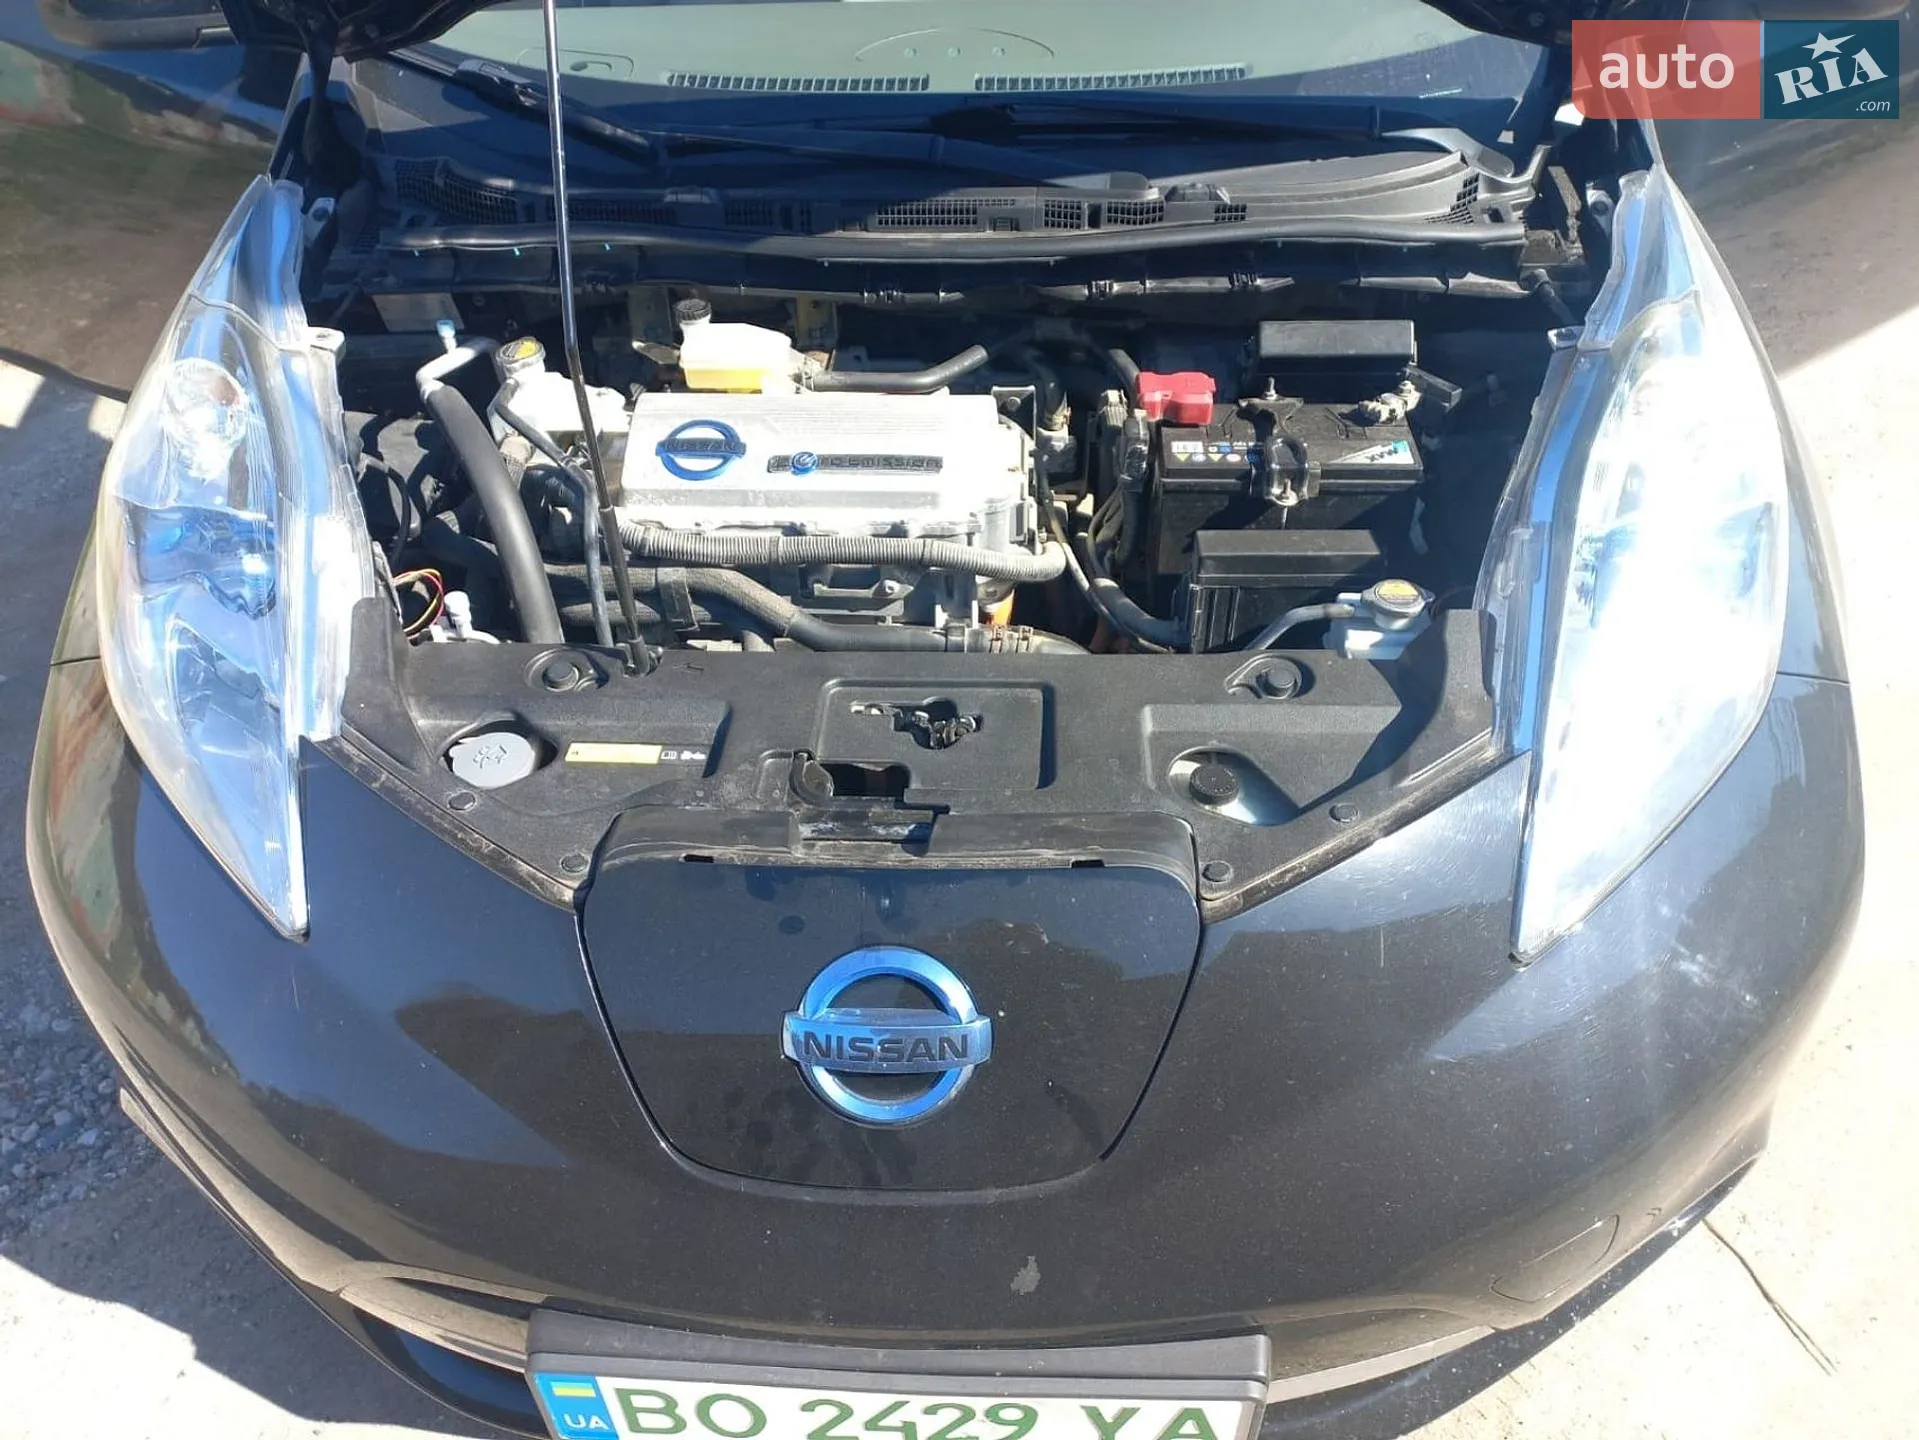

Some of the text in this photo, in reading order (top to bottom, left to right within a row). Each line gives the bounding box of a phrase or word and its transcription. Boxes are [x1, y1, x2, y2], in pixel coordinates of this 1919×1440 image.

[803, 1031, 969, 1063] NISSAN
[563, 1412, 610, 1431] UA
[614, 1387, 1219, 1440] BO 2429 YA
